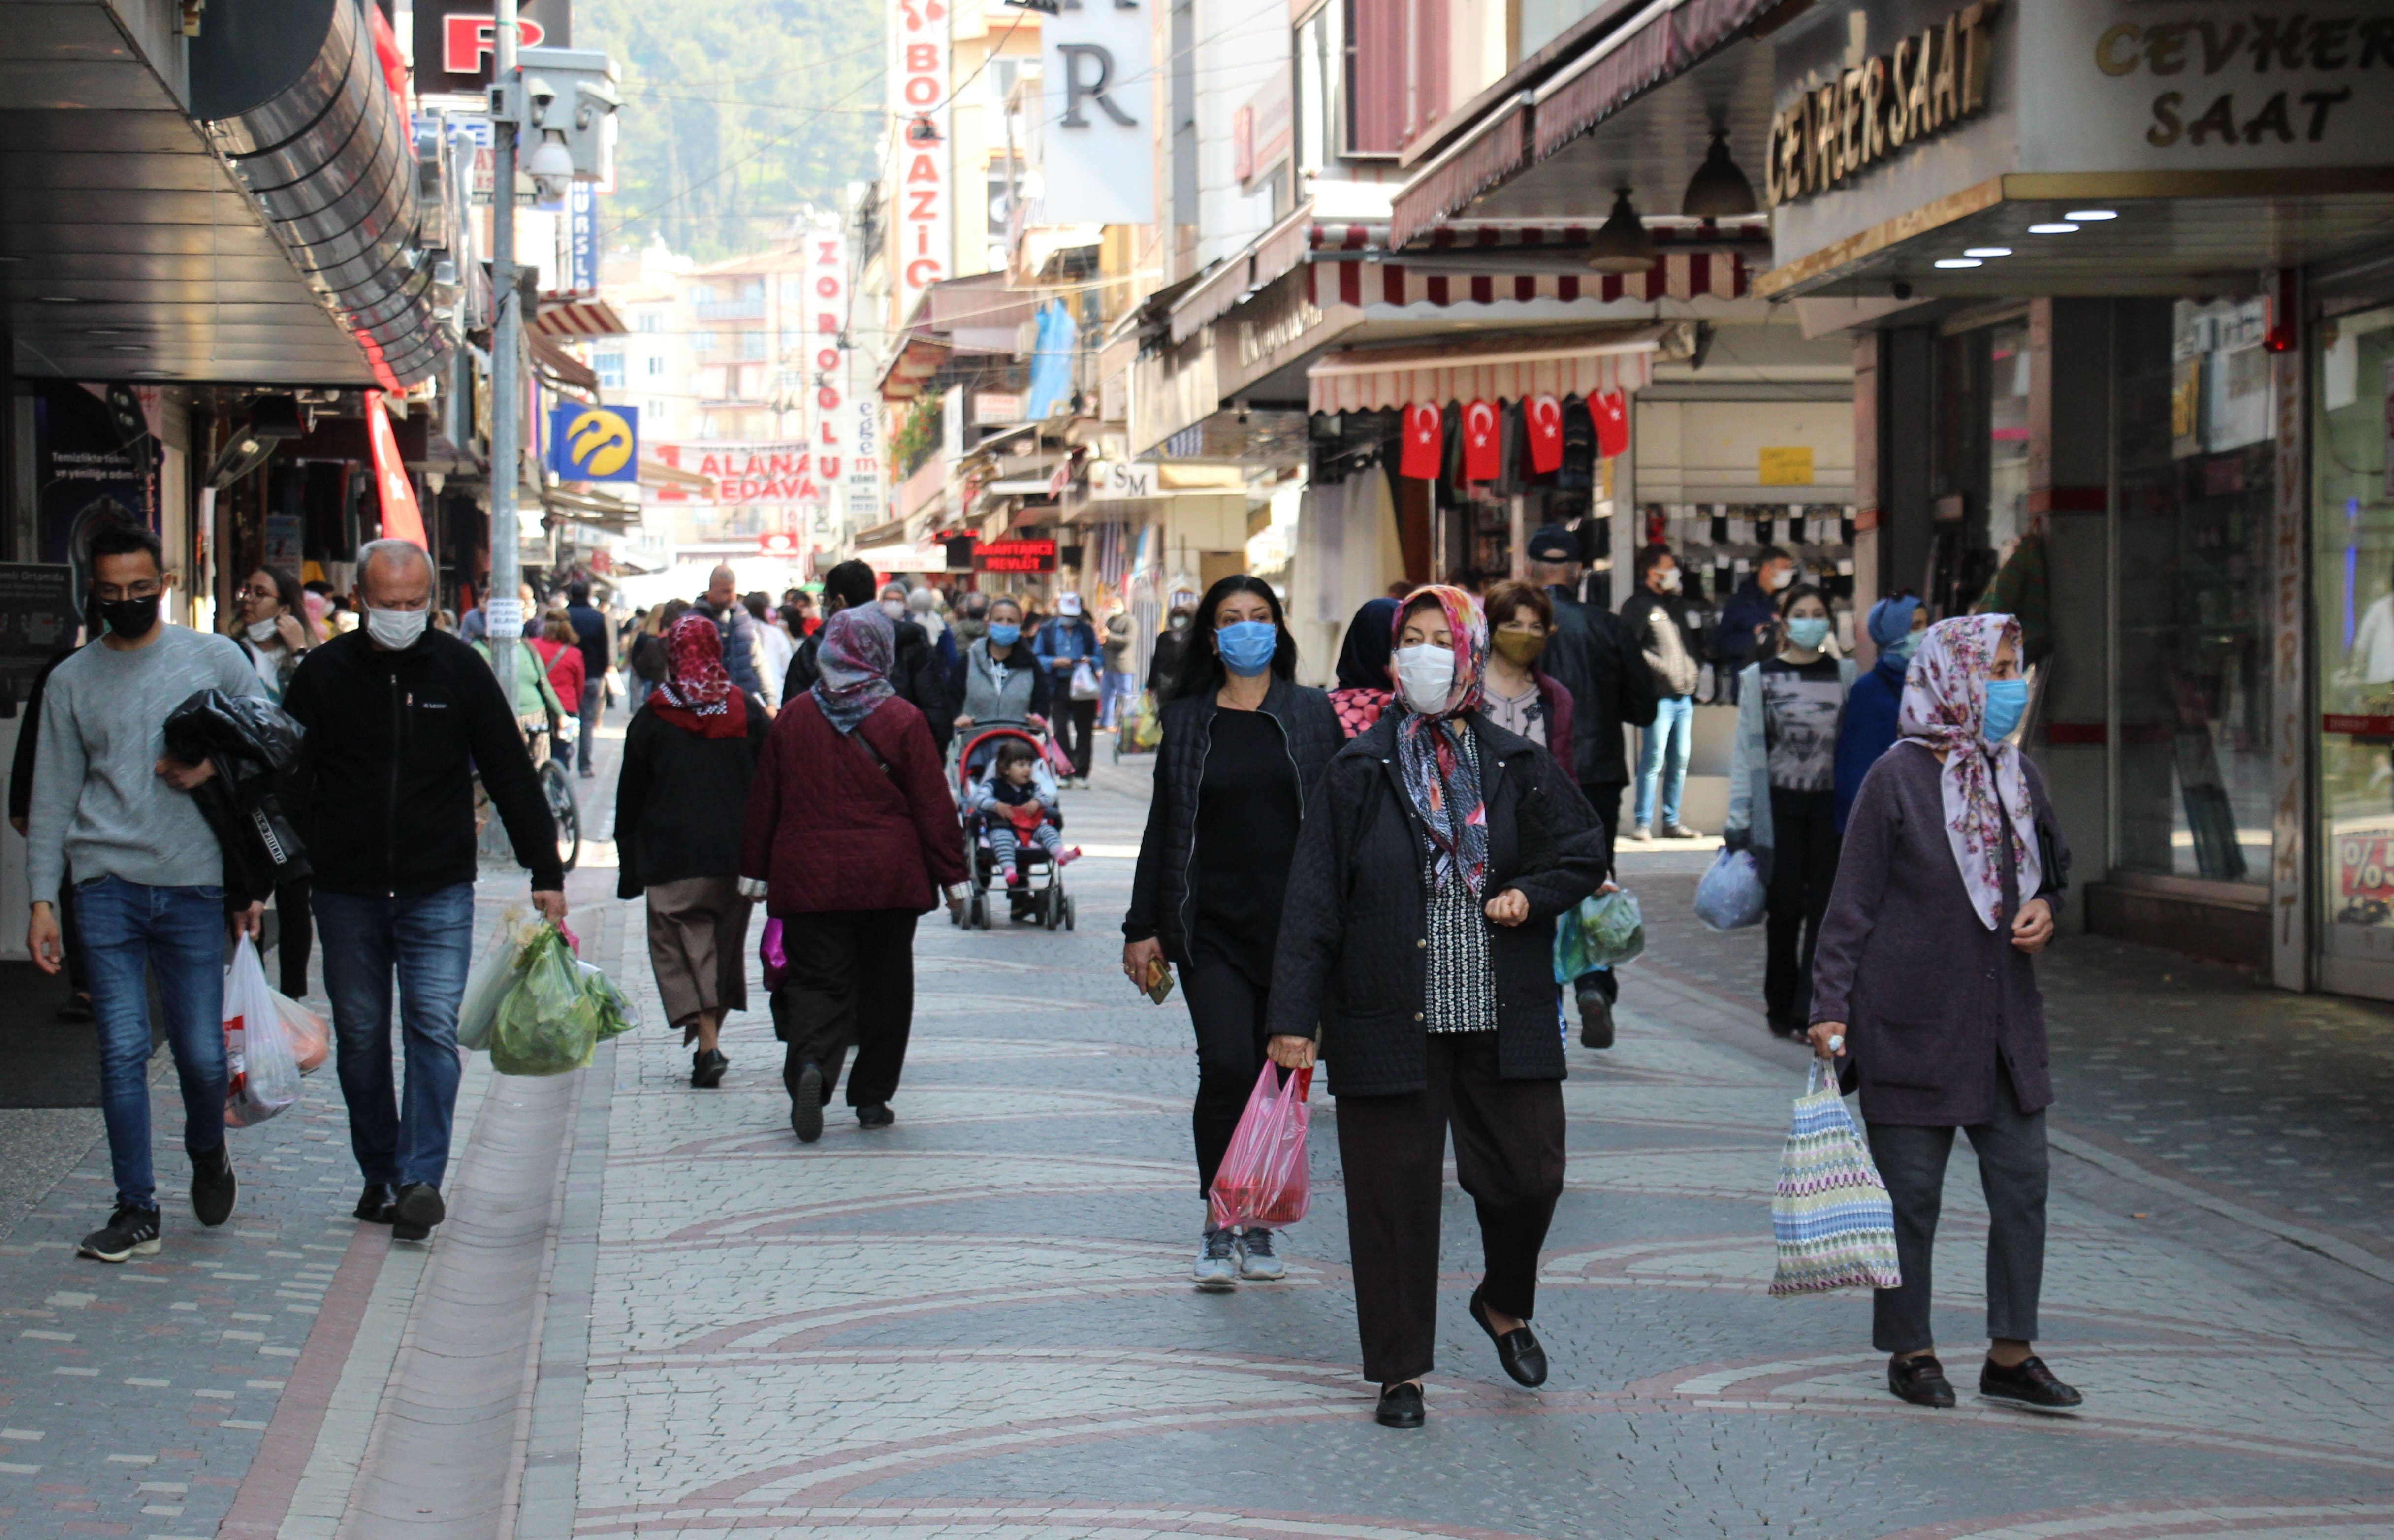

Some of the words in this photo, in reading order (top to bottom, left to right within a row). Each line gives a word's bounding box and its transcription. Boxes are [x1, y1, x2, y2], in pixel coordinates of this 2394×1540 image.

[2096, 13, 2394, 77] CEVHER
[1766, 55, 1884, 207] CEVHER
[1889, 5, 1983, 147] SAAT
[2146, 86, 2352, 147] SAAT
[699, 454, 810, 477] ALANA
[700, 479, 819, 499] EDAVA
